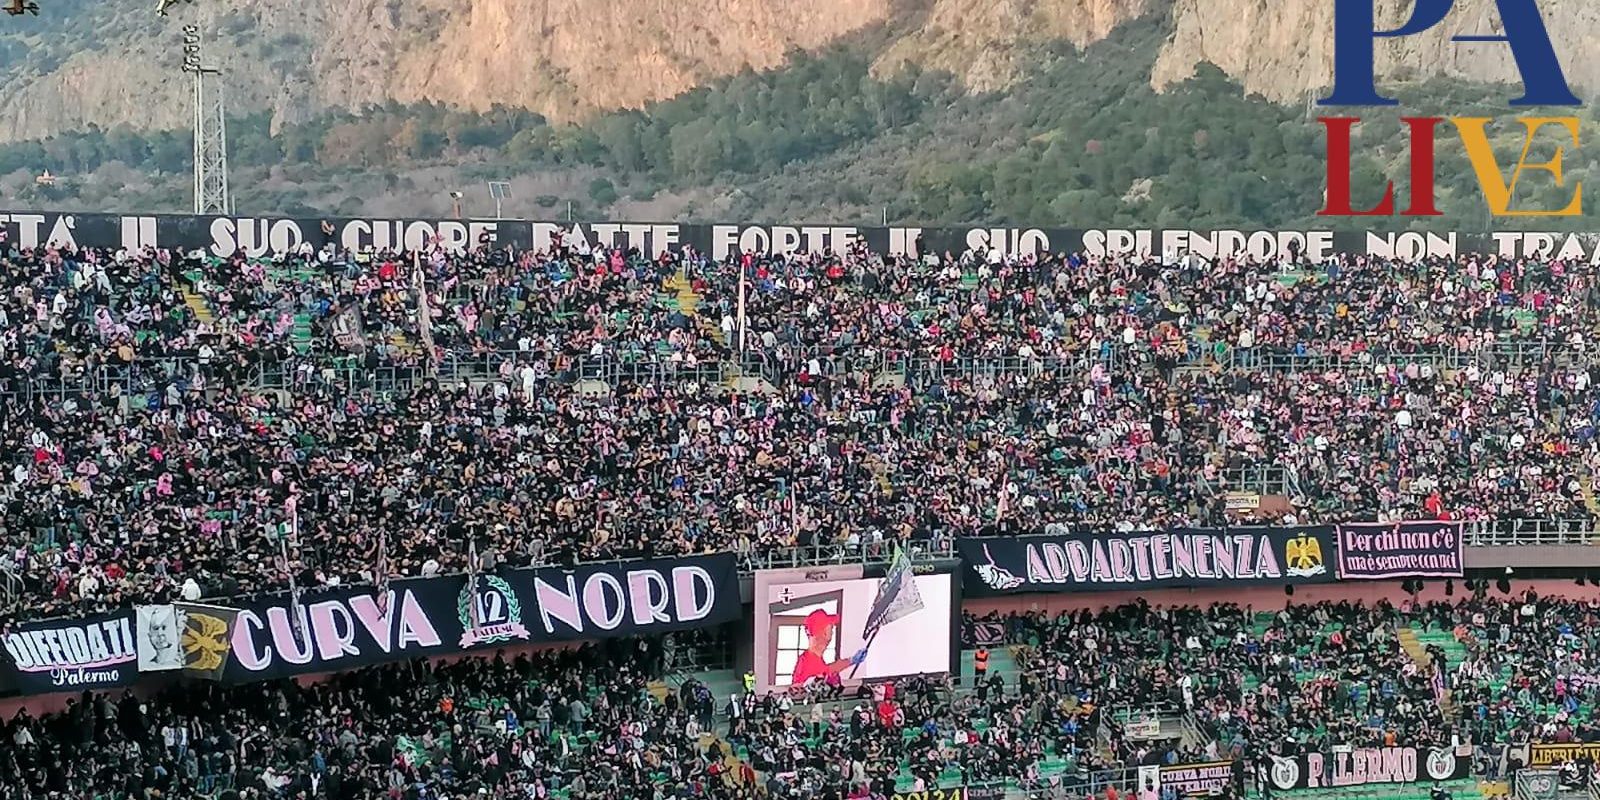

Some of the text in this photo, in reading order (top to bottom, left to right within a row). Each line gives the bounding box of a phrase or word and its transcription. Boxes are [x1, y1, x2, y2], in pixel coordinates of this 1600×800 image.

[209, 218, 301, 258] SUO
[341, 220, 498, 258] CUORE
[712, 225, 858, 262] FORTE
[1366, 231, 1457, 264] NON
[1026, 534, 1281, 584] APPARTENENZA
[1345, 531, 1373, 552] Per
[1375, 529, 1400, 551] chi
[1401, 531, 1430, 551] non
[231, 566, 716, 671] CURVA NORD
[476, 590, 506, 624] 12
[0, 617, 136, 668] DIFFIDATI
[50, 666, 119, 686] Palermo
[1308, 747, 1418, 788] PLERMO
